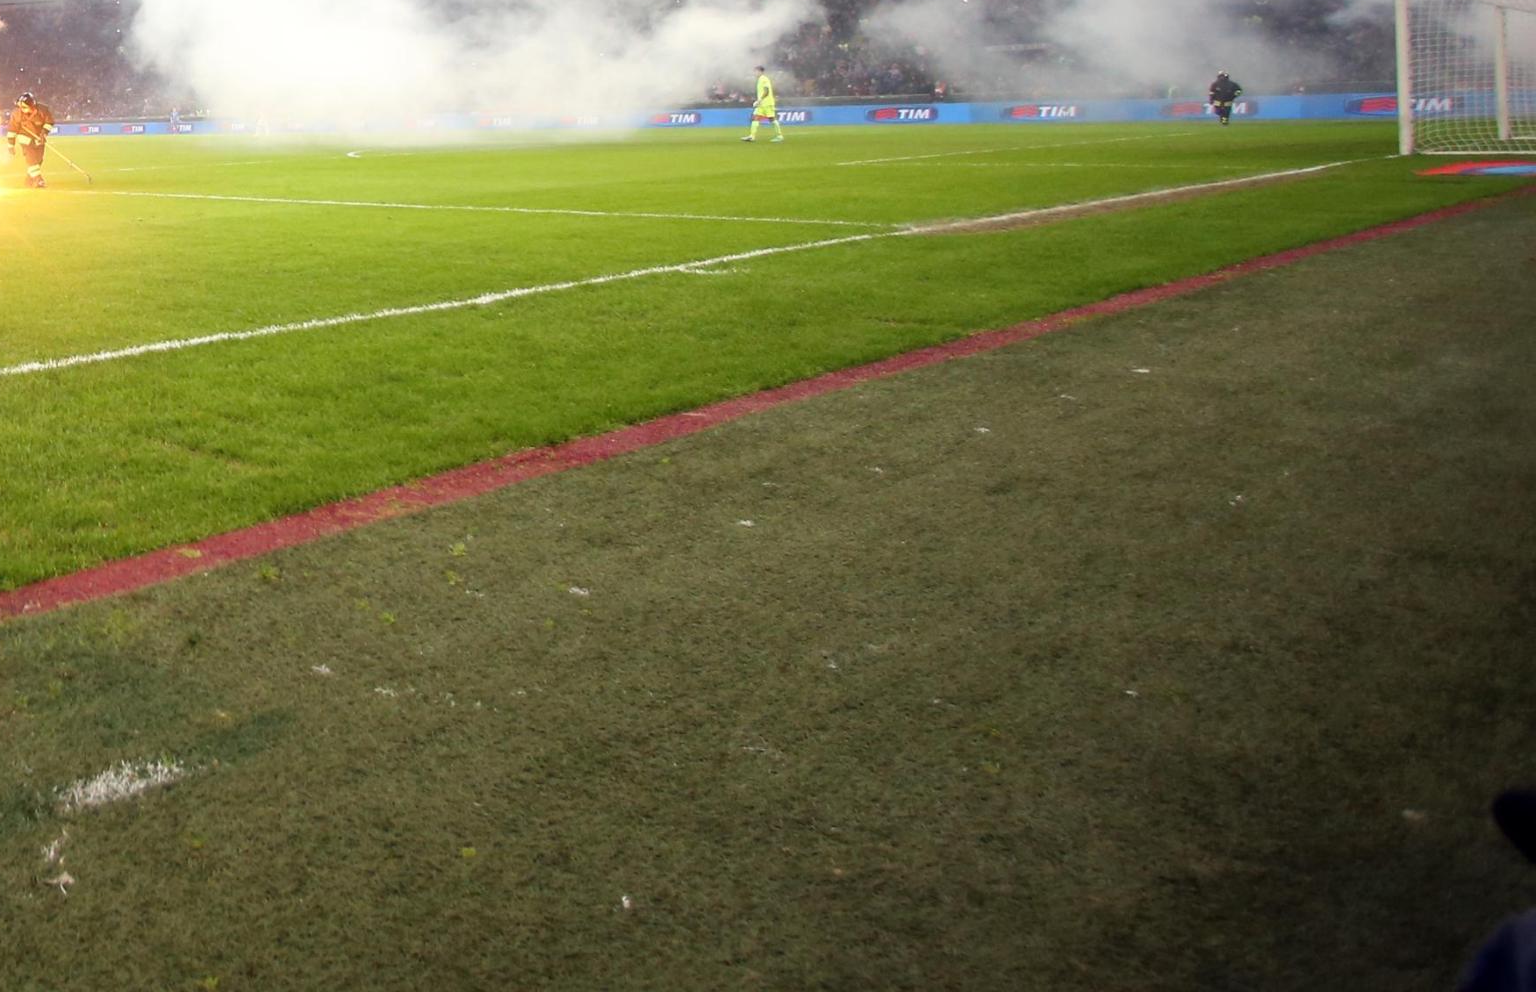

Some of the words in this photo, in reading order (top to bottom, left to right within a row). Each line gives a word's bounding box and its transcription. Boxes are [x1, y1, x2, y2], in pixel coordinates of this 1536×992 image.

[1203, 102, 1247, 114] TM
[1408, 96, 1453, 111] IM
[777, 112, 805, 121] TIM
[898, 109, 930, 120] TIM
[1038, 106, 1077, 117] TIM
[670, 114, 696, 123] TIM
